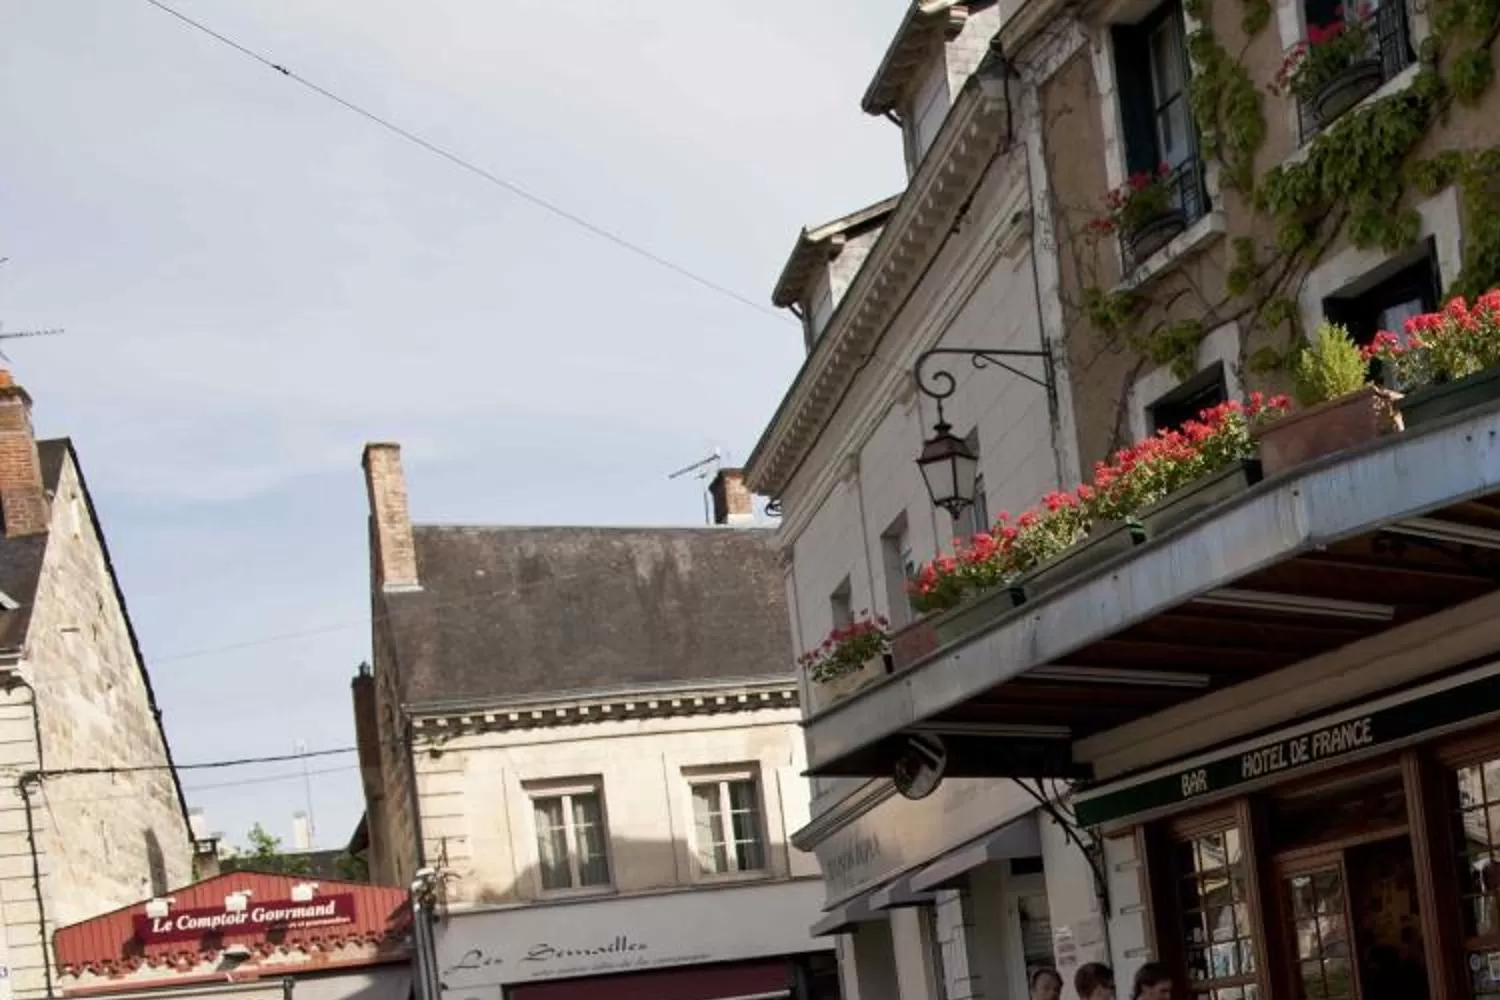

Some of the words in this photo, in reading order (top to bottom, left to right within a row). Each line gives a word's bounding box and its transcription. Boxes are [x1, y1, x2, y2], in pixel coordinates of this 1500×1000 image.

[1181, 770, 1208, 797] BAR
[1241, 745, 1289, 777] HOTEL
[1290, 737, 1310, 763] DE
[1312, 717, 1374, 758] FRANCE
[152, 918, 173, 933] Le
[176, 912, 248, 931] Comptoir
[251, 900, 336, 923] Gourmand
